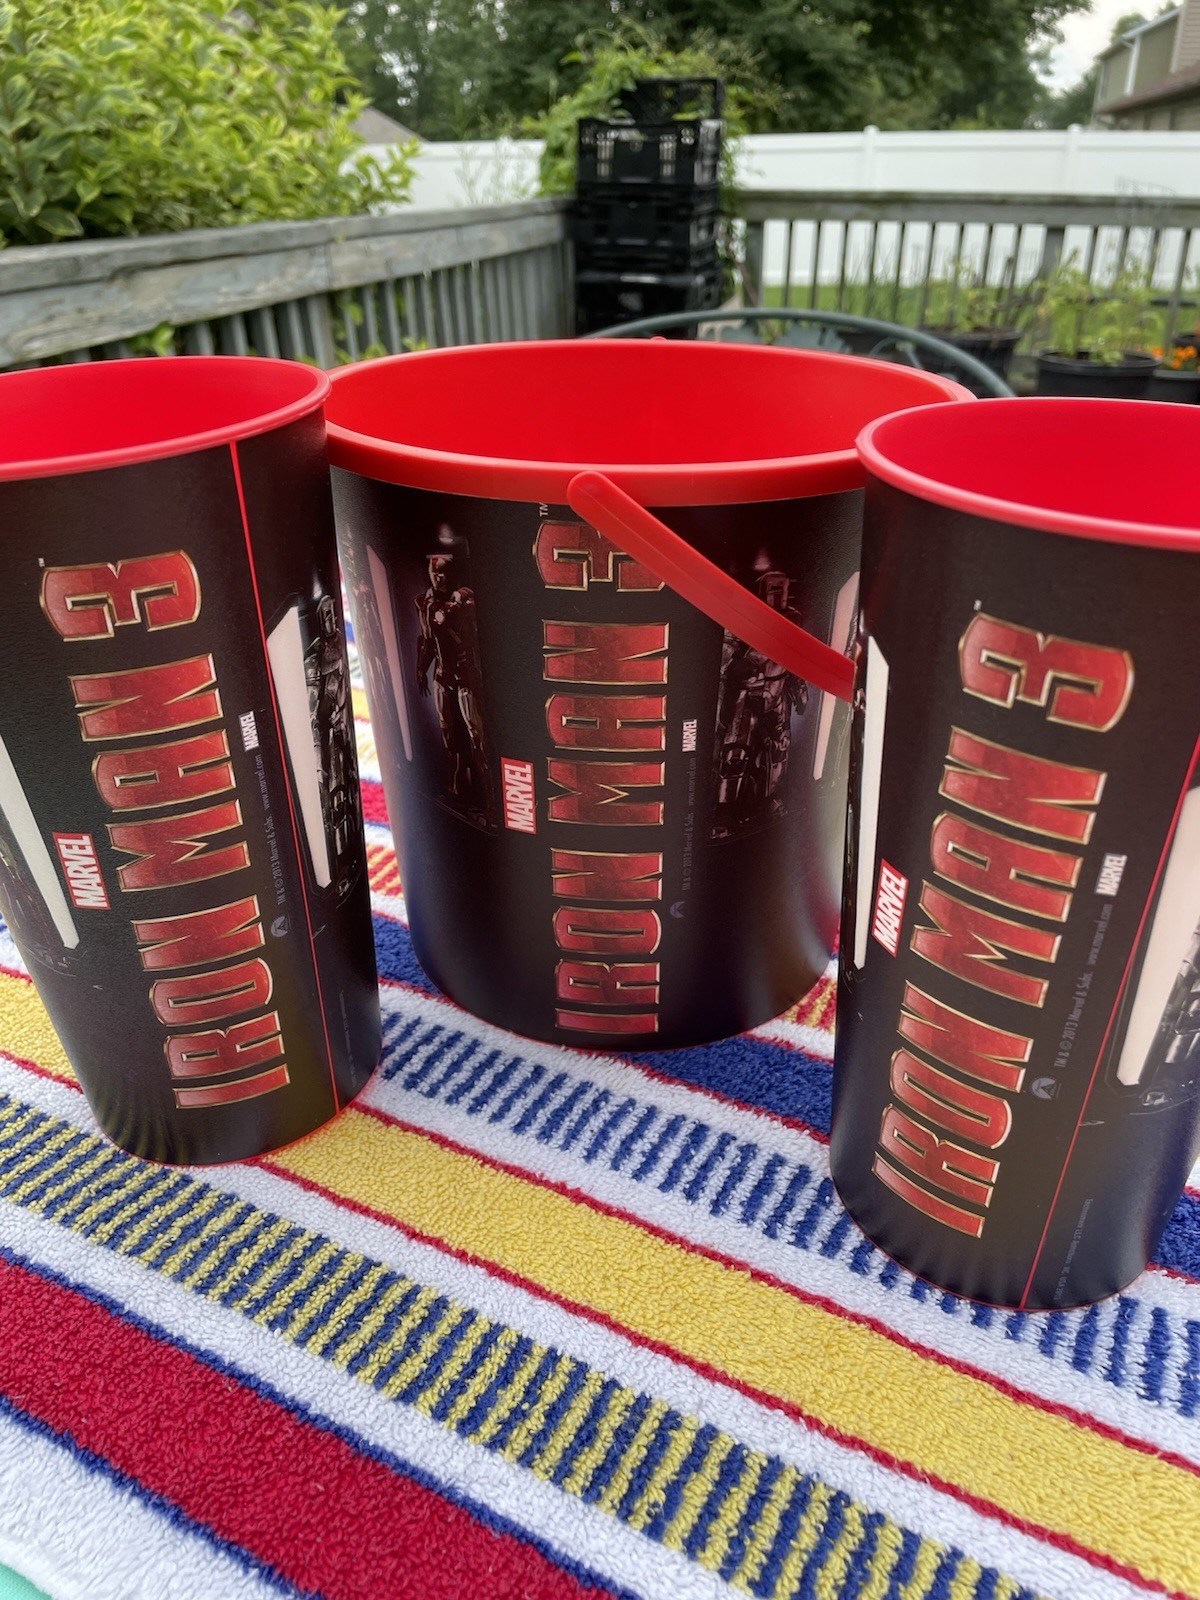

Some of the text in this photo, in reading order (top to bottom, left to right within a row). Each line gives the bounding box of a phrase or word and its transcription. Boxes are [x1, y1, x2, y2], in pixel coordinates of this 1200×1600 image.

[538, 501, 549, 517] TM
[239, 711, 260, 752] MARVEL
[682, 719, 698, 752] MARVEL
[254, 753, 270, 810] www.marvel.com
[501, 757, 537, 834] MARVEL
[532, 519, 670, 1033] IRON MAN 3
[40, 549, 291, 1110] IRON MAN 3
[267, 839, 280, 862] Marvel
[682, 833, 693, 852] Marvel
[52, 832, 110, 910] MARVEL
[271, 862, 283, 878] 2013
[1094, 852, 1128, 897] MARVEL
[871, 611, 1134, 1239] IRON MAN 3
[872, 859, 909, 957] MARVEL
[1062, 1021, 1078, 1040] 2013
[1070, 997, 1087, 1021] Marvel
